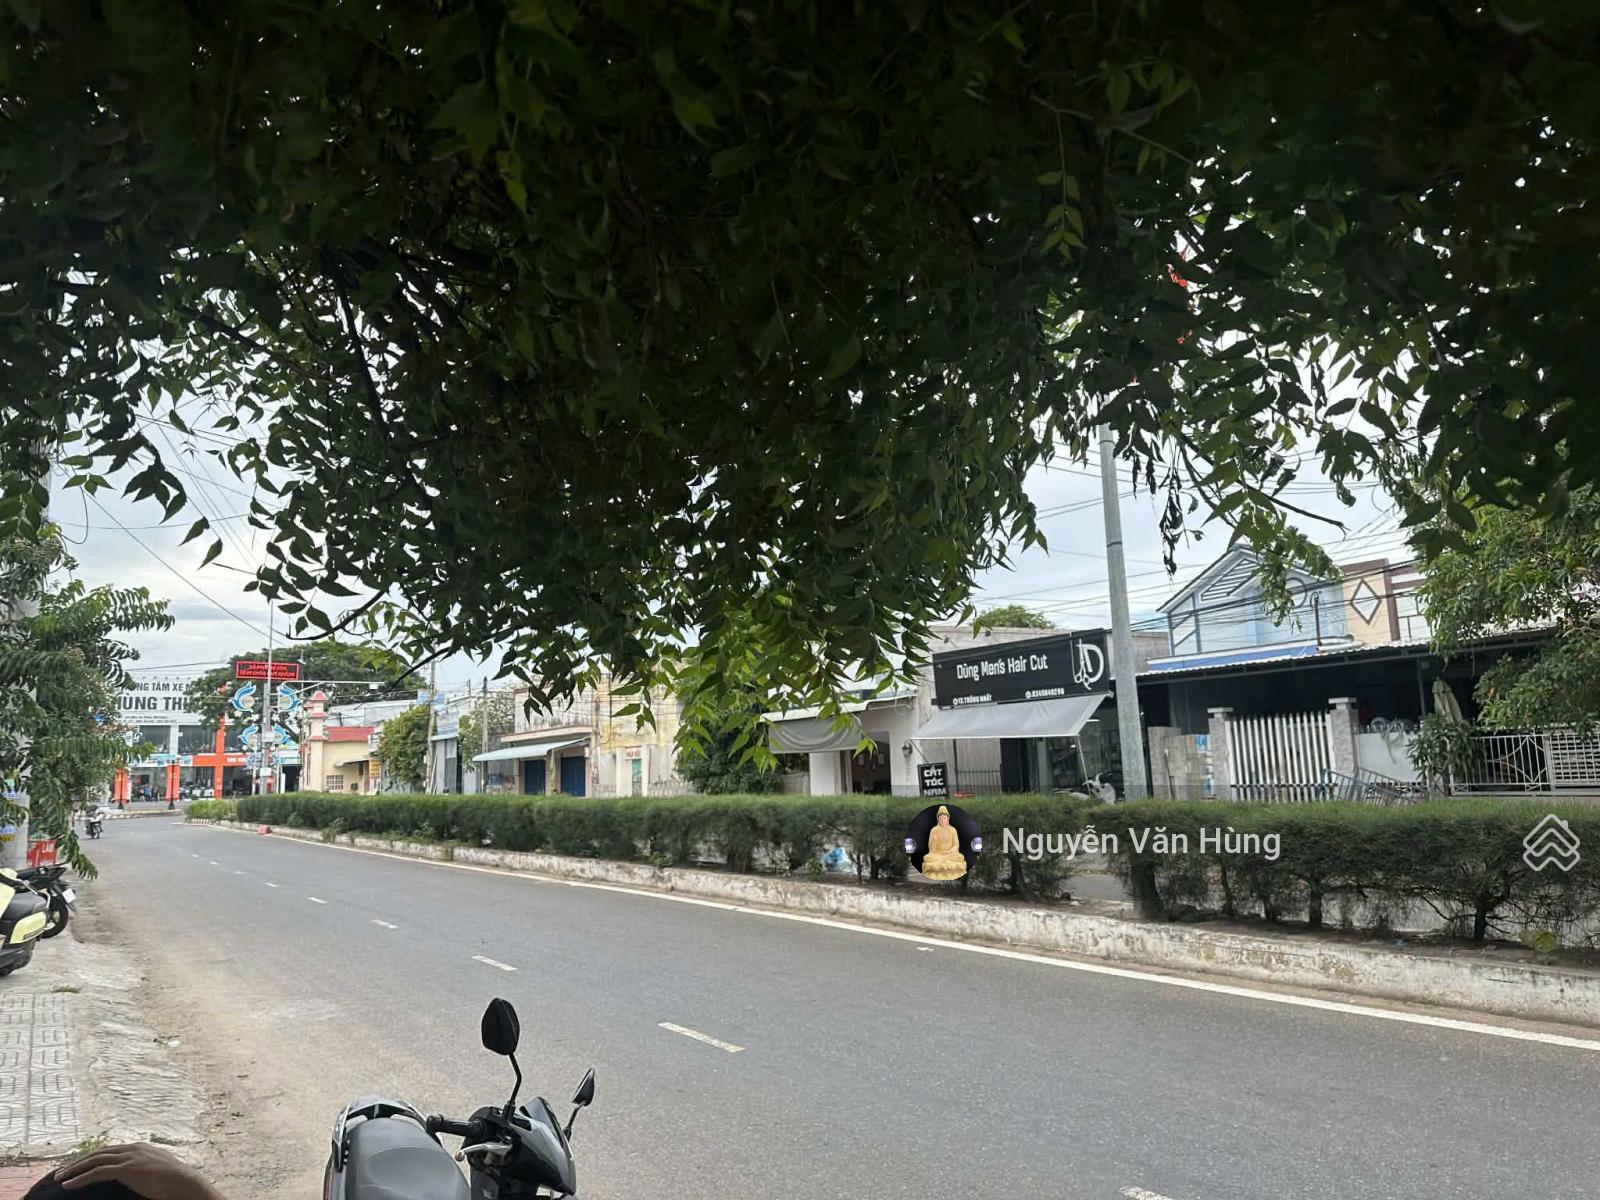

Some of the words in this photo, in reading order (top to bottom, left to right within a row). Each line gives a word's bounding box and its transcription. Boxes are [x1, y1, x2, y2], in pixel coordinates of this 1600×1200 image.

[956, 662, 980, 682] Dũng
[981, 659, 1006, 677] Men's
[1008, 655, 1028, 674] Hair
[1030, 653, 1049, 670] Cut
[172, 682, 184, 692] XE
[924, 777, 944, 787] TÓC
[923, 787, 947, 797] NAM
